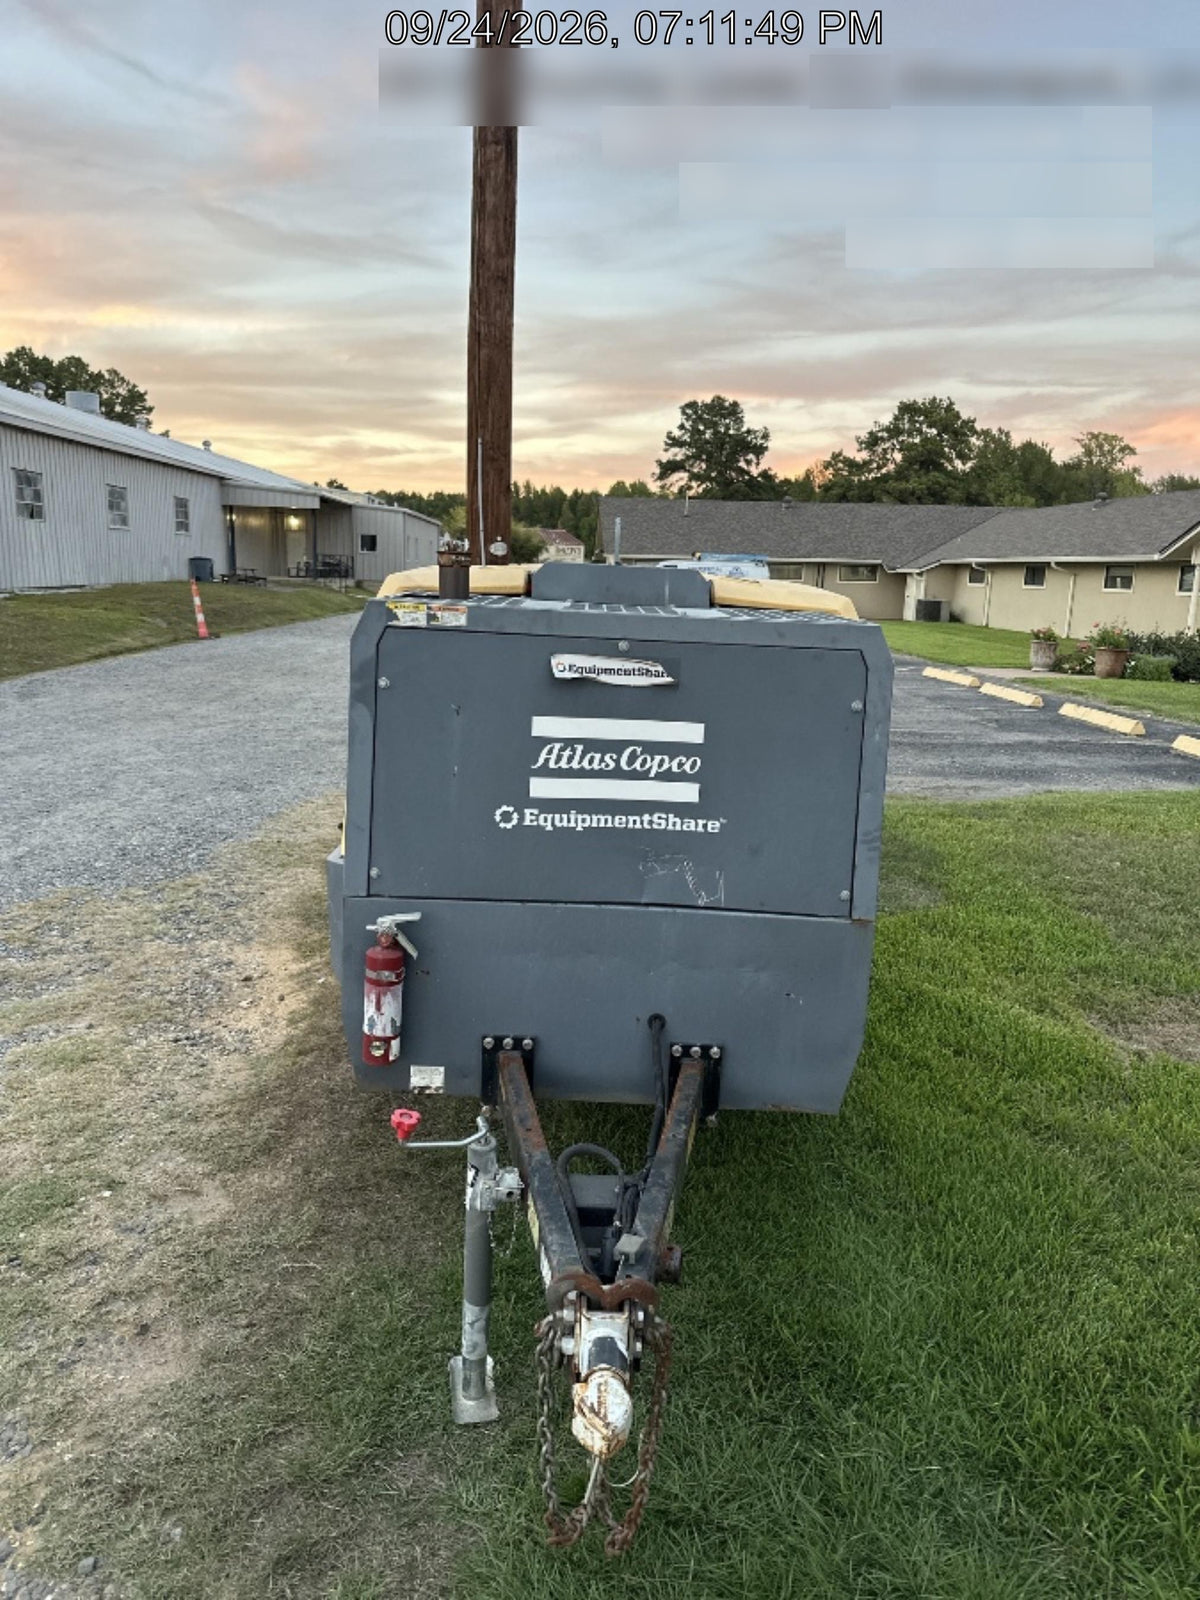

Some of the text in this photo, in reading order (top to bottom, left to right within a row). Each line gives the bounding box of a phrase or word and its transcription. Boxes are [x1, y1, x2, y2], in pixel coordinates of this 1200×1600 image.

[531, 743, 702, 778] Atlas Copco
[522, 808, 721, 834] EquipmentShare
